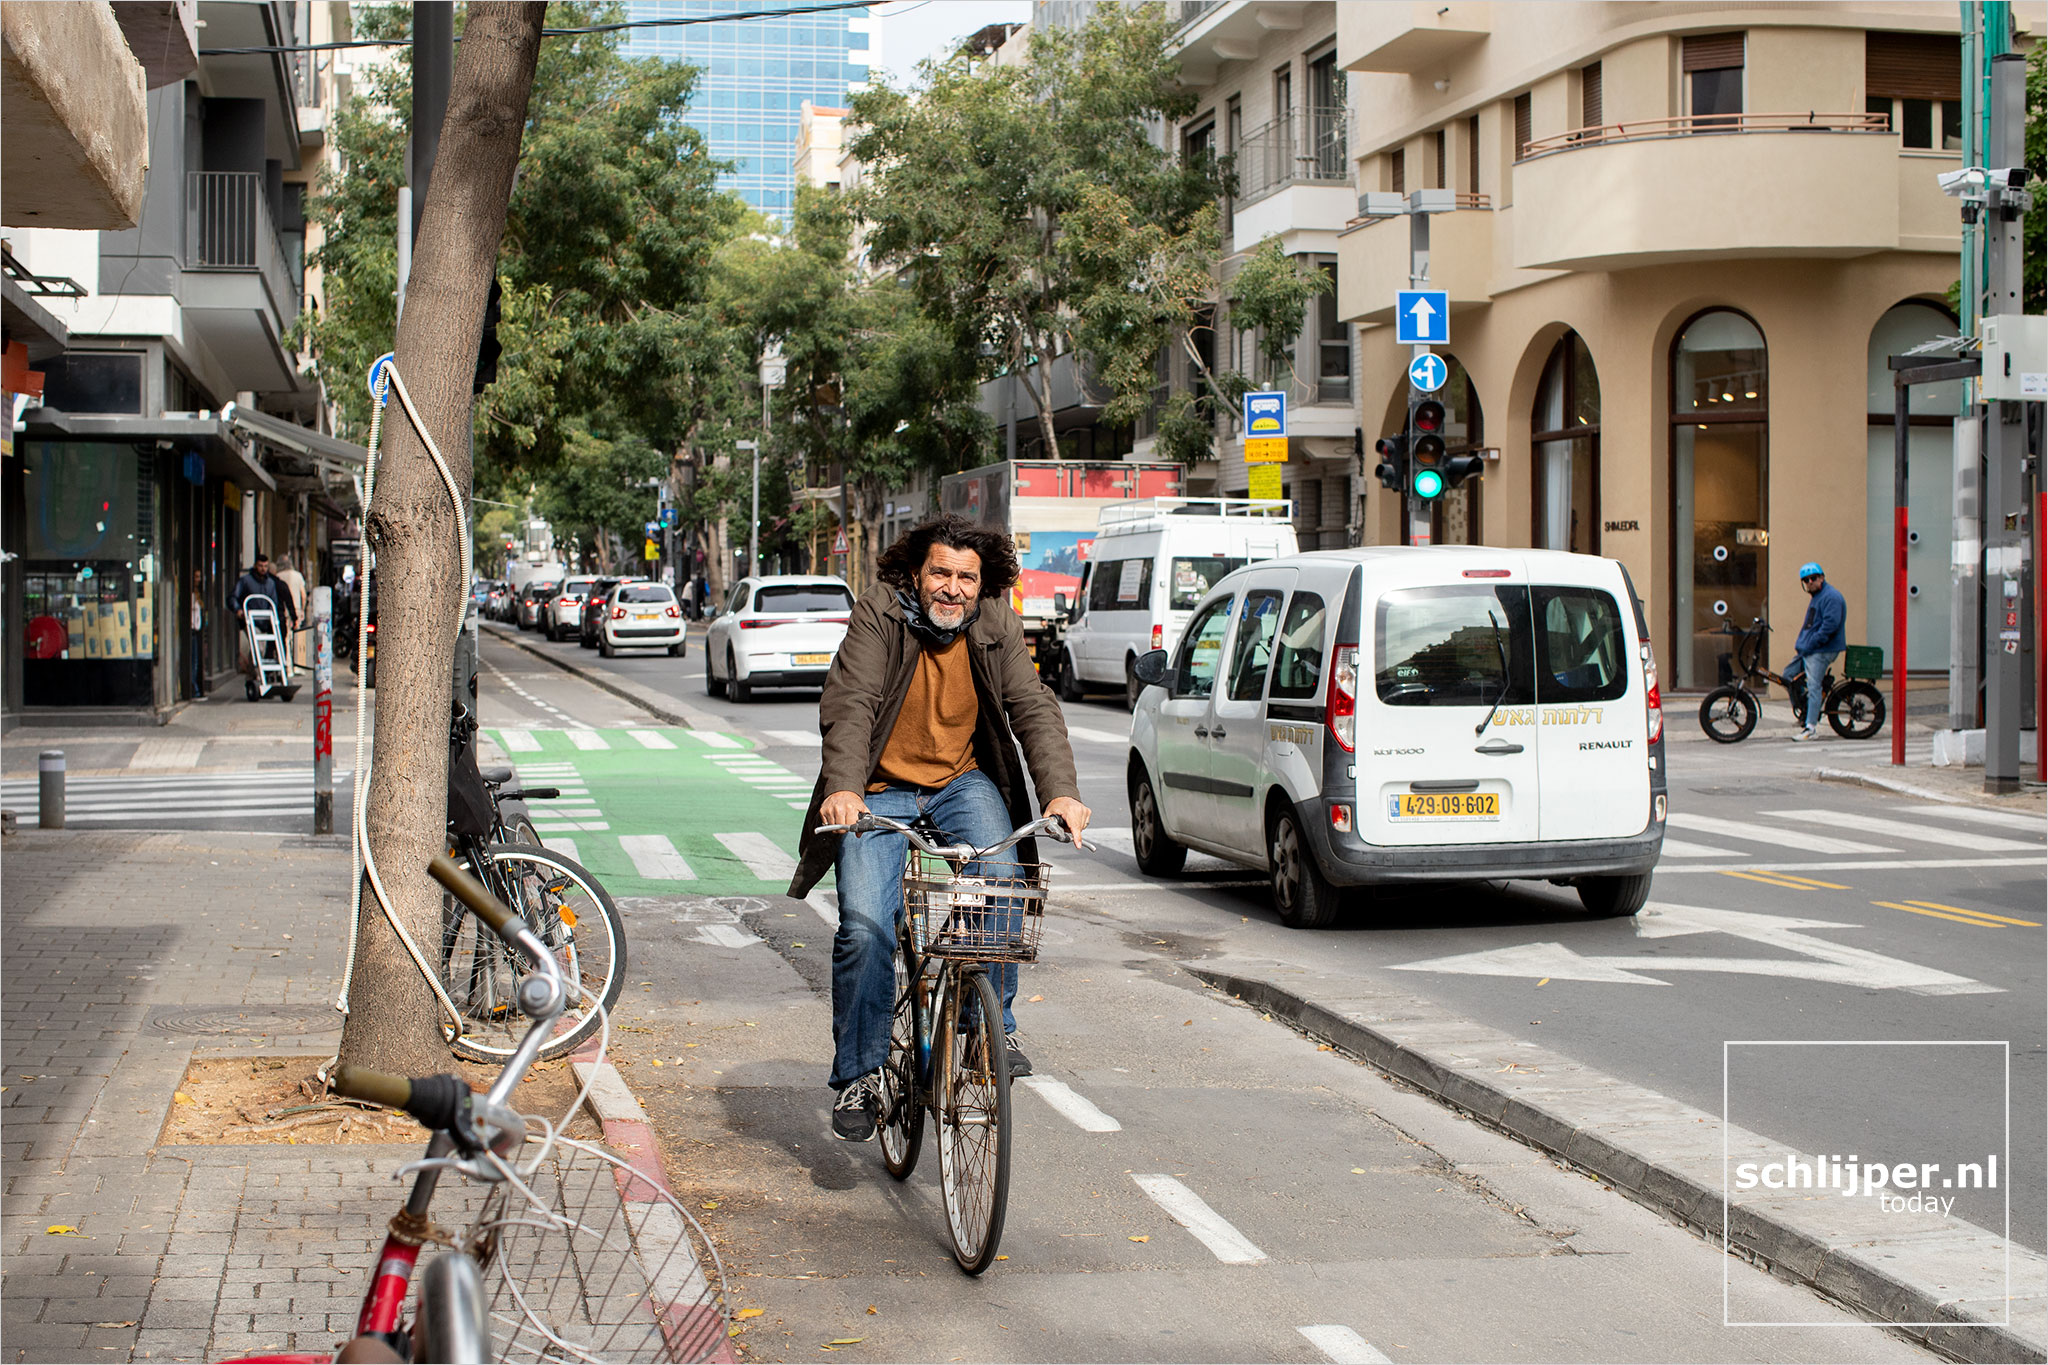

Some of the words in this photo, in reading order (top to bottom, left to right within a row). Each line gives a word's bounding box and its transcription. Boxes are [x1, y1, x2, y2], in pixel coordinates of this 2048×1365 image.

[1492, 709, 1535, 726] גאש
[1542, 705, 1603, 725] דלתות
[1579, 740, 1633, 751] RENAULT
